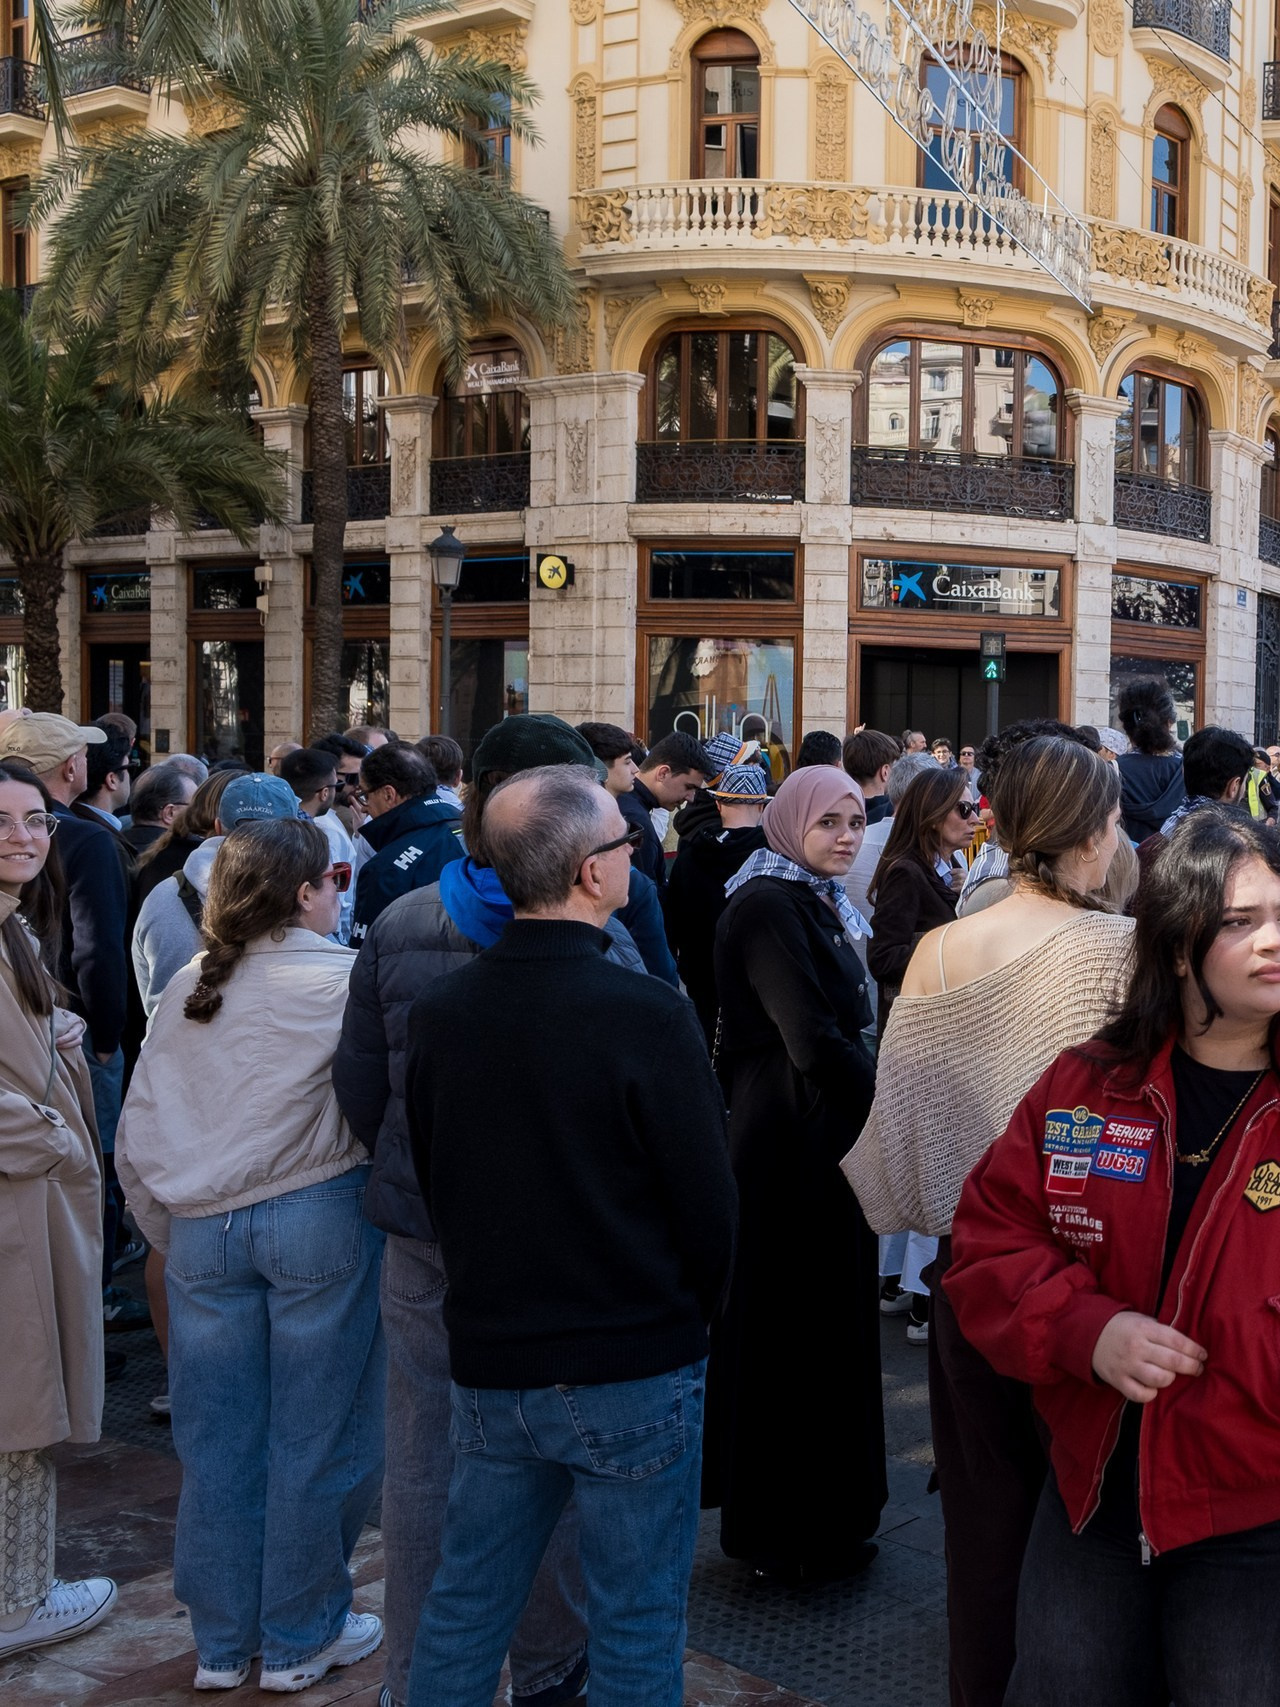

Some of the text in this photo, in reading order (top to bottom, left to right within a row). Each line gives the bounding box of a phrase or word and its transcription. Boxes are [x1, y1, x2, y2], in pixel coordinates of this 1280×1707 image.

[479, 360, 520, 375] CaixaBank
[932, 575, 1035, 600] CaixaBank
[393, 845, 424, 871] HH
[1045, 1121, 1070, 1136] EST
[1106, 1122, 1154, 1141] SERVICE
[1112, 1137, 1143, 1147] STATION
[1053, 1159, 1073, 1171] WEST
[1096, 1150, 1145, 1176] WG91
[1255, 1195, 1273, 1206] 1991
